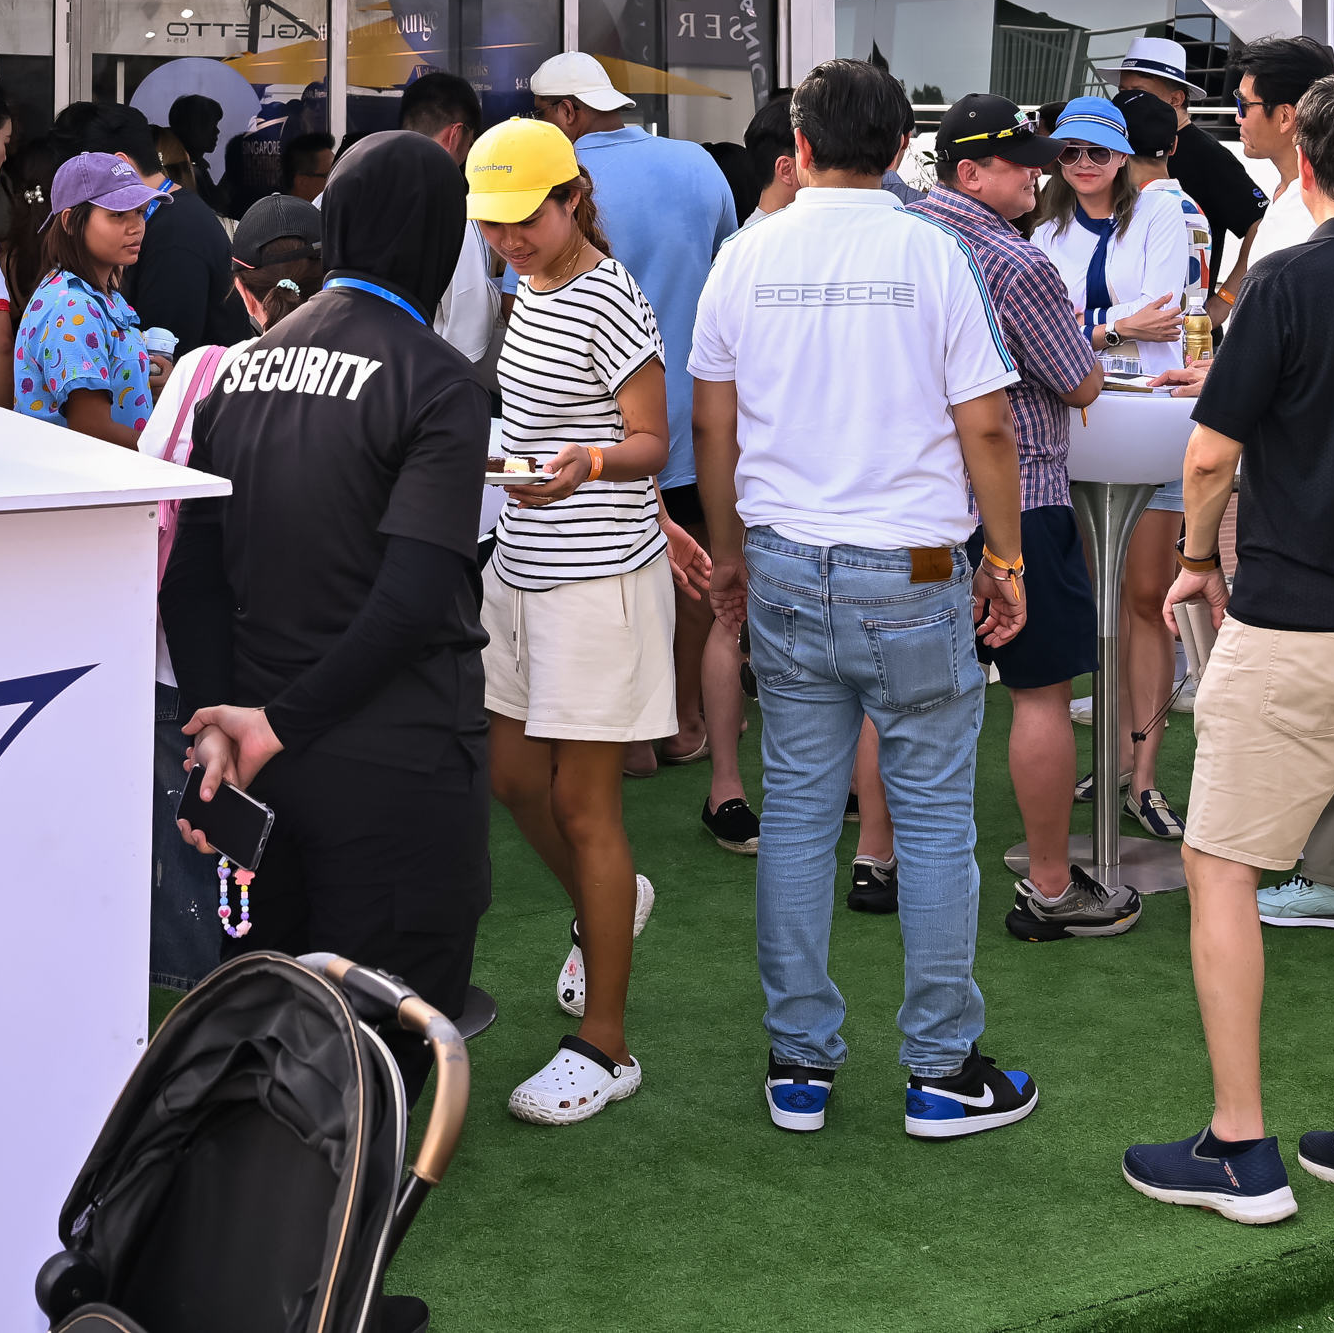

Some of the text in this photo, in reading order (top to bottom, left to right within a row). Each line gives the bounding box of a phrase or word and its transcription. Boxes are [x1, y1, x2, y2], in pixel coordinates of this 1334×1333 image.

[242, 140, 281, 155] SINGAPORE
[474, 163, 512, 173] Bloomberg
[755, 286, 914, 303] PORSCHE
[223, 347, 383, 401] SECURITY
